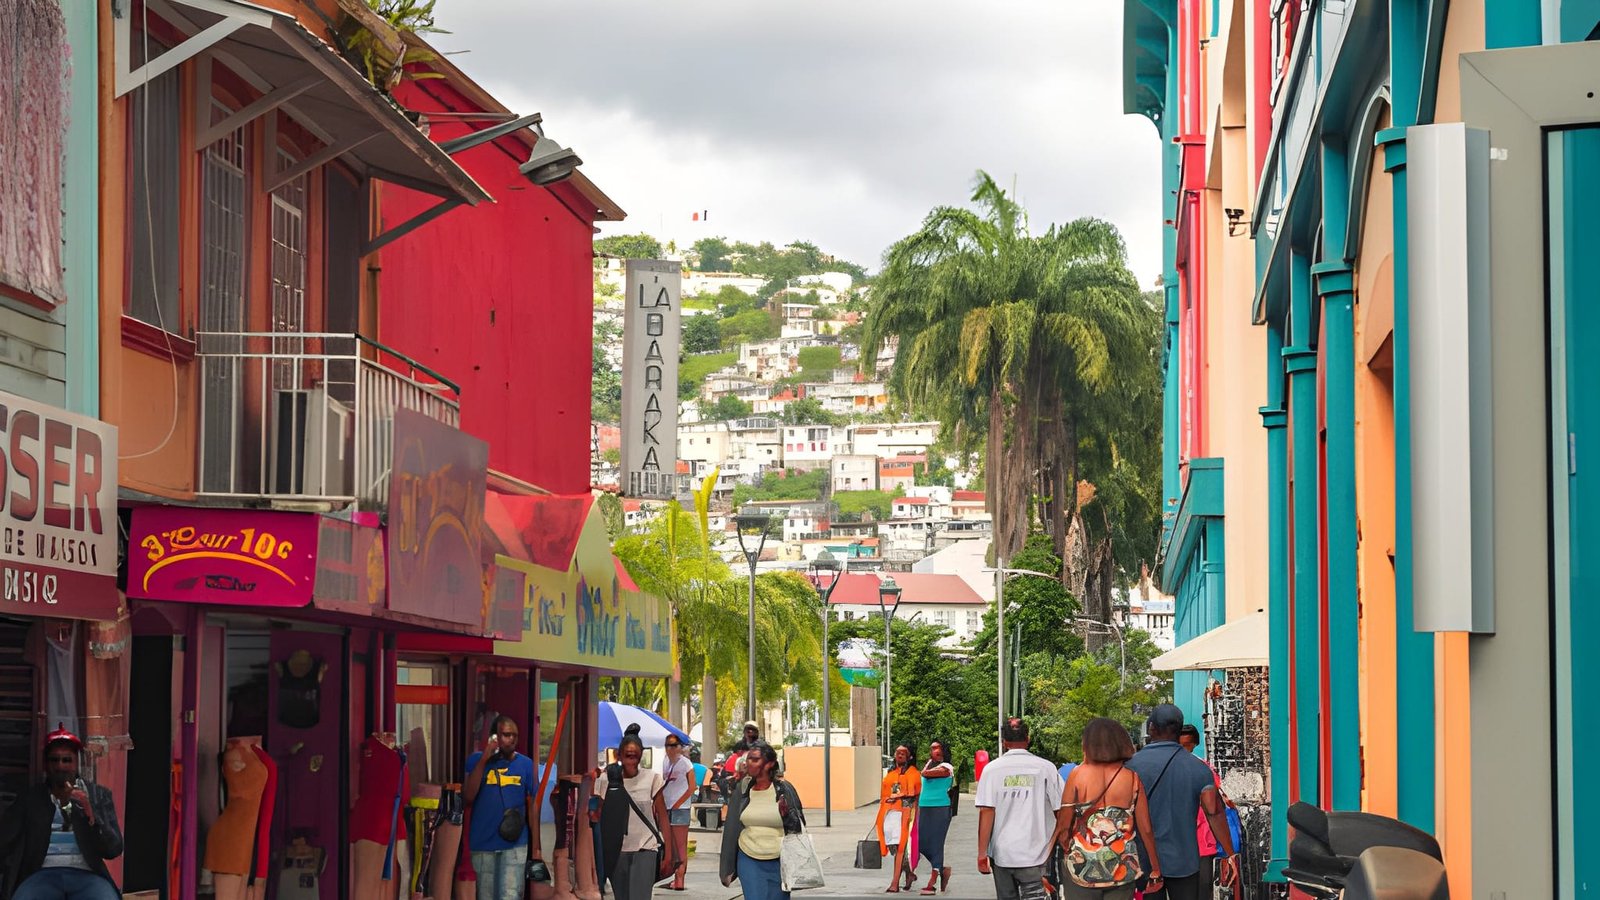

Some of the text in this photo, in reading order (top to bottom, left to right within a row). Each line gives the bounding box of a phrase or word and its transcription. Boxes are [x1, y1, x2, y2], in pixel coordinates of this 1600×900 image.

[639, 283, 672, 312] LA
[0, 403, 103, 535] SER
[140, 534, 165, 562] 3
